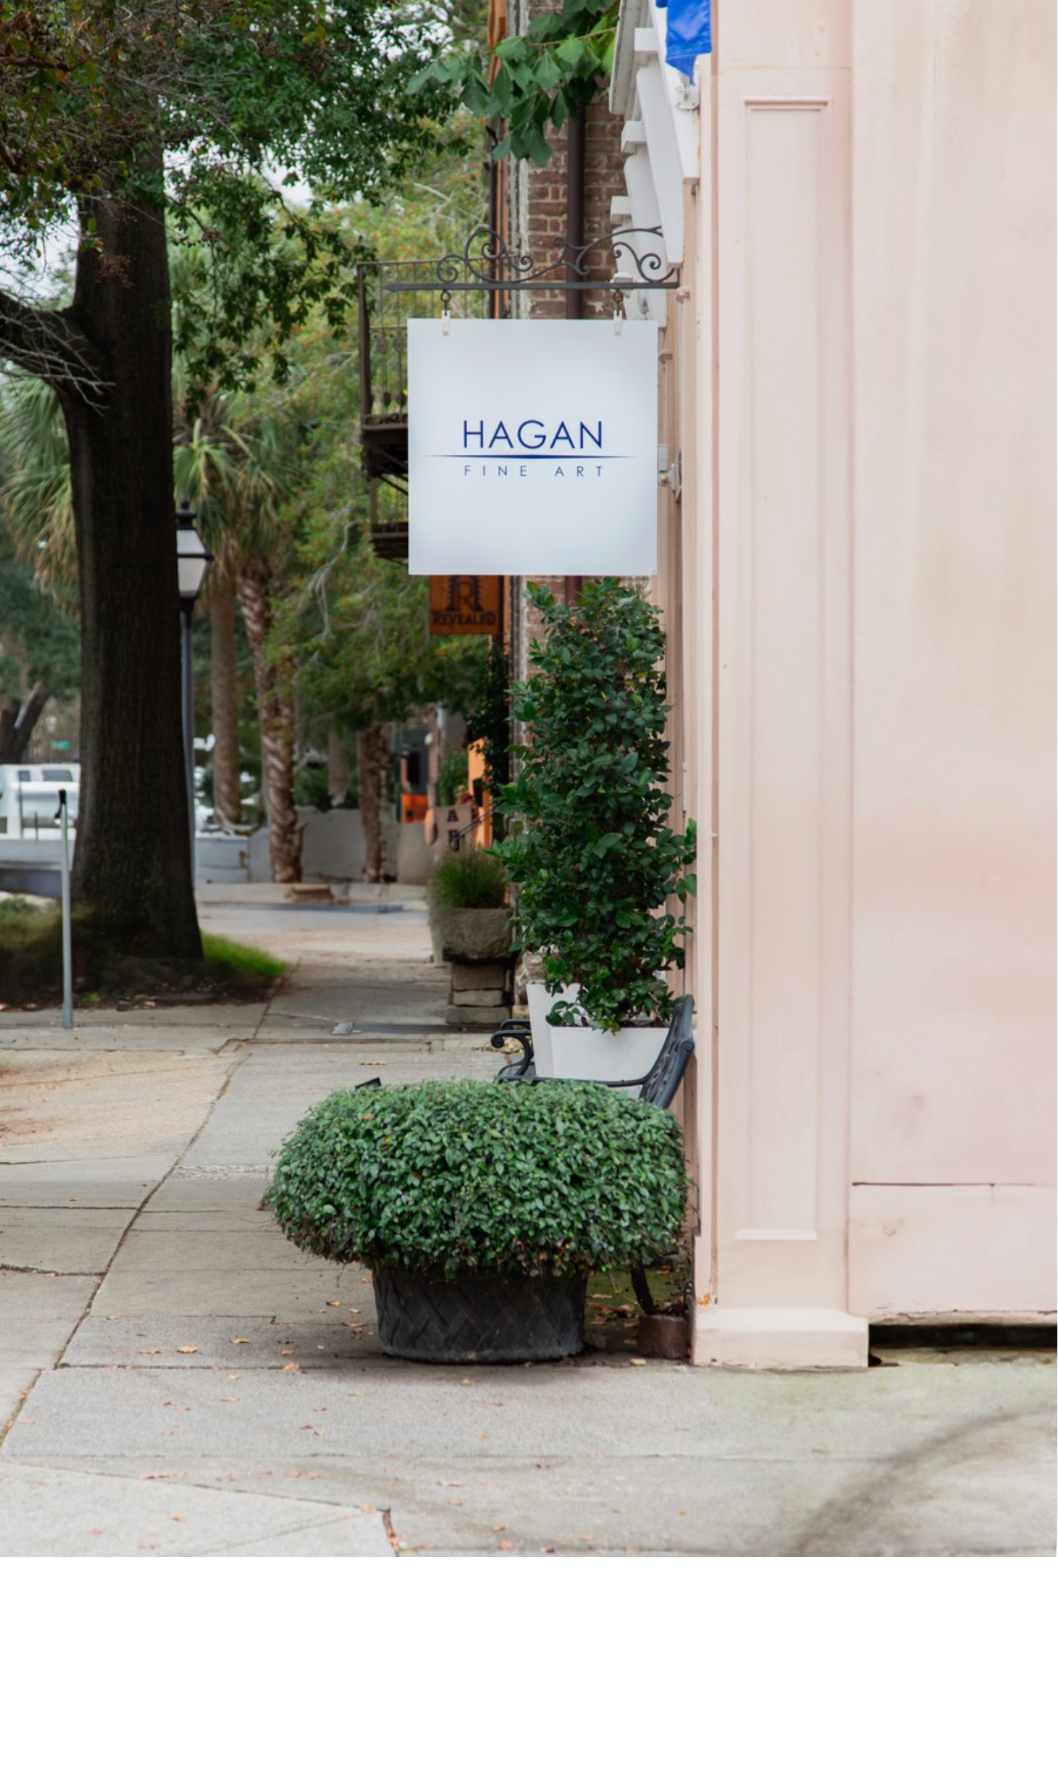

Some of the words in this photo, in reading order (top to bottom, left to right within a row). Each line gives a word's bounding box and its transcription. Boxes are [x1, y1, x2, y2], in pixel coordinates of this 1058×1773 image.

[463, 419, 602, 449] HAGAN
[464, 465, 527, 477] FINE
[554, 466, 602, 477] ART
[433, 611, 496, 626] REVEALED
